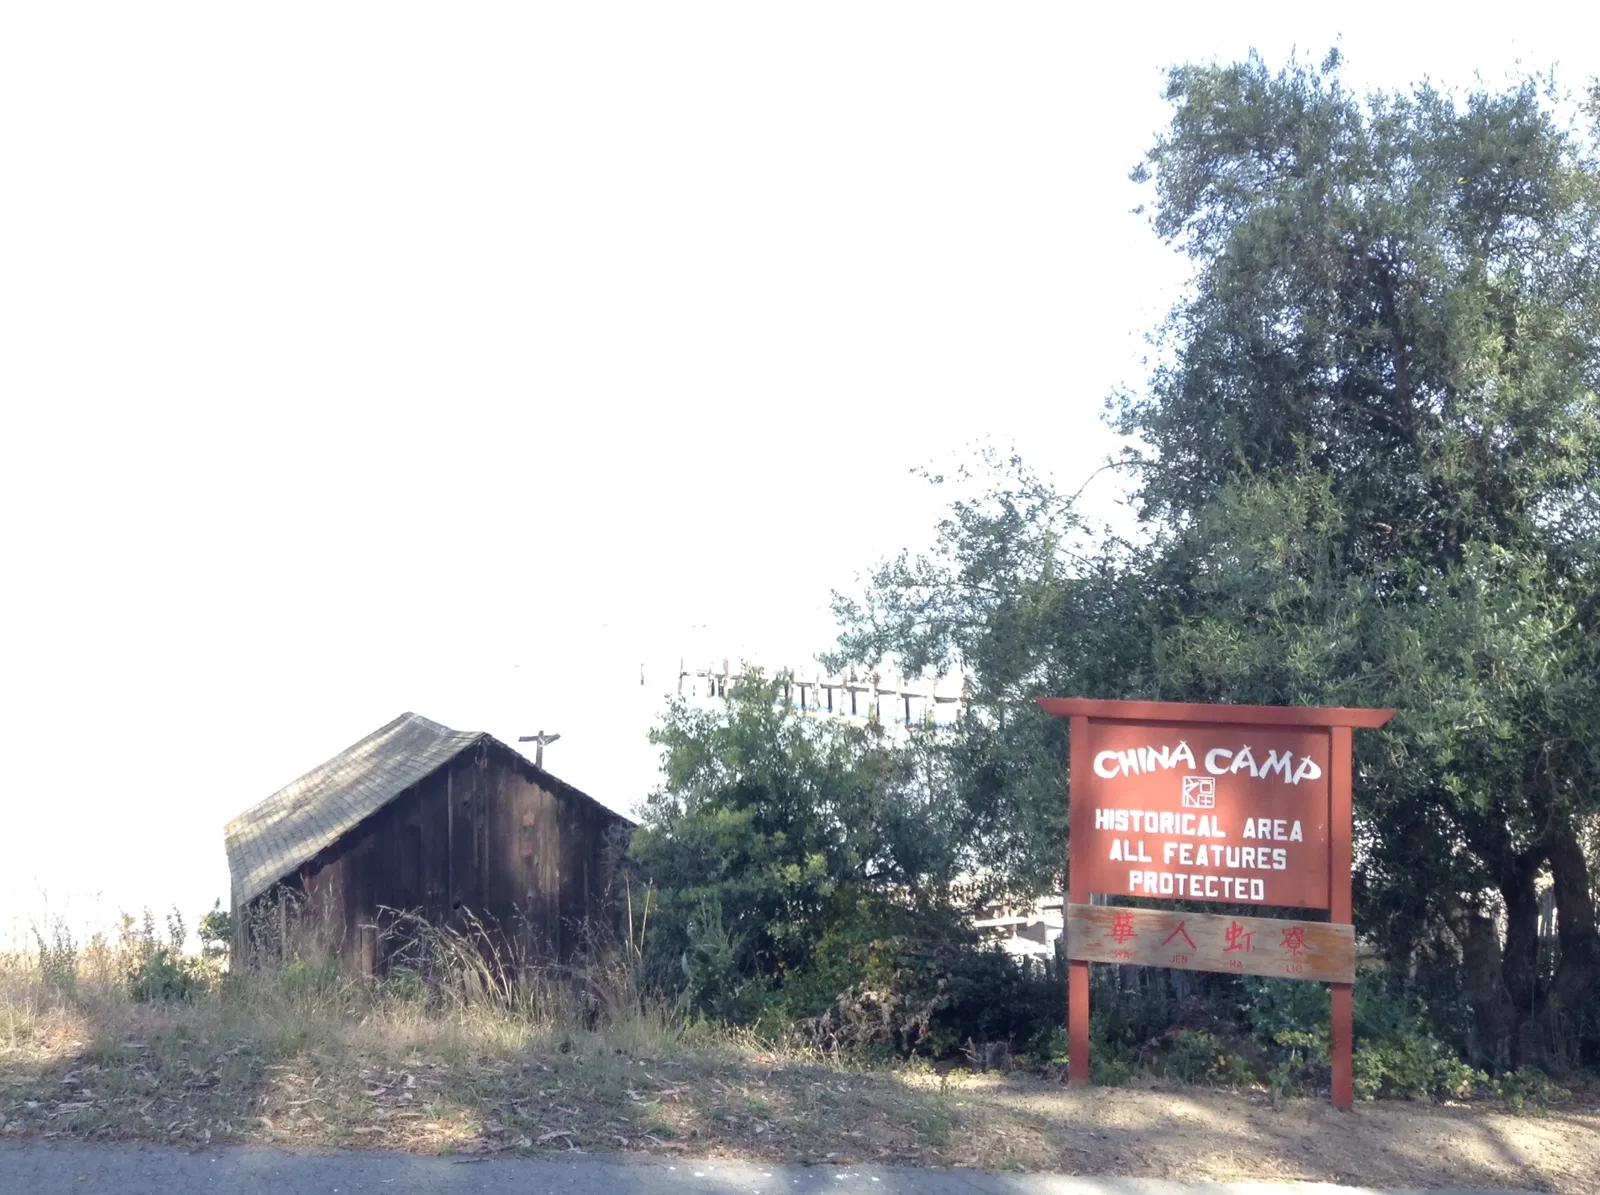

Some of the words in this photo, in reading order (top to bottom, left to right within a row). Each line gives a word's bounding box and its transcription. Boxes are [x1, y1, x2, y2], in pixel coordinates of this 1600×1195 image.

[1093, 740, 1196, 779] CHINA
[1204, 744, 1322, 785] CAMP
[1095, 808, 1226, 838] HISTORICAL
[1242, 817, 1304, 843] AREA
[1109, 838, 1152, 862] ALL
[1163, 842, 1287, 871] FEATURES
[1128, 870, 1265, 901] PROTECTED
[1168, 953, 1189, 965] JEN
[1229, 959, 1244, 970] HA
